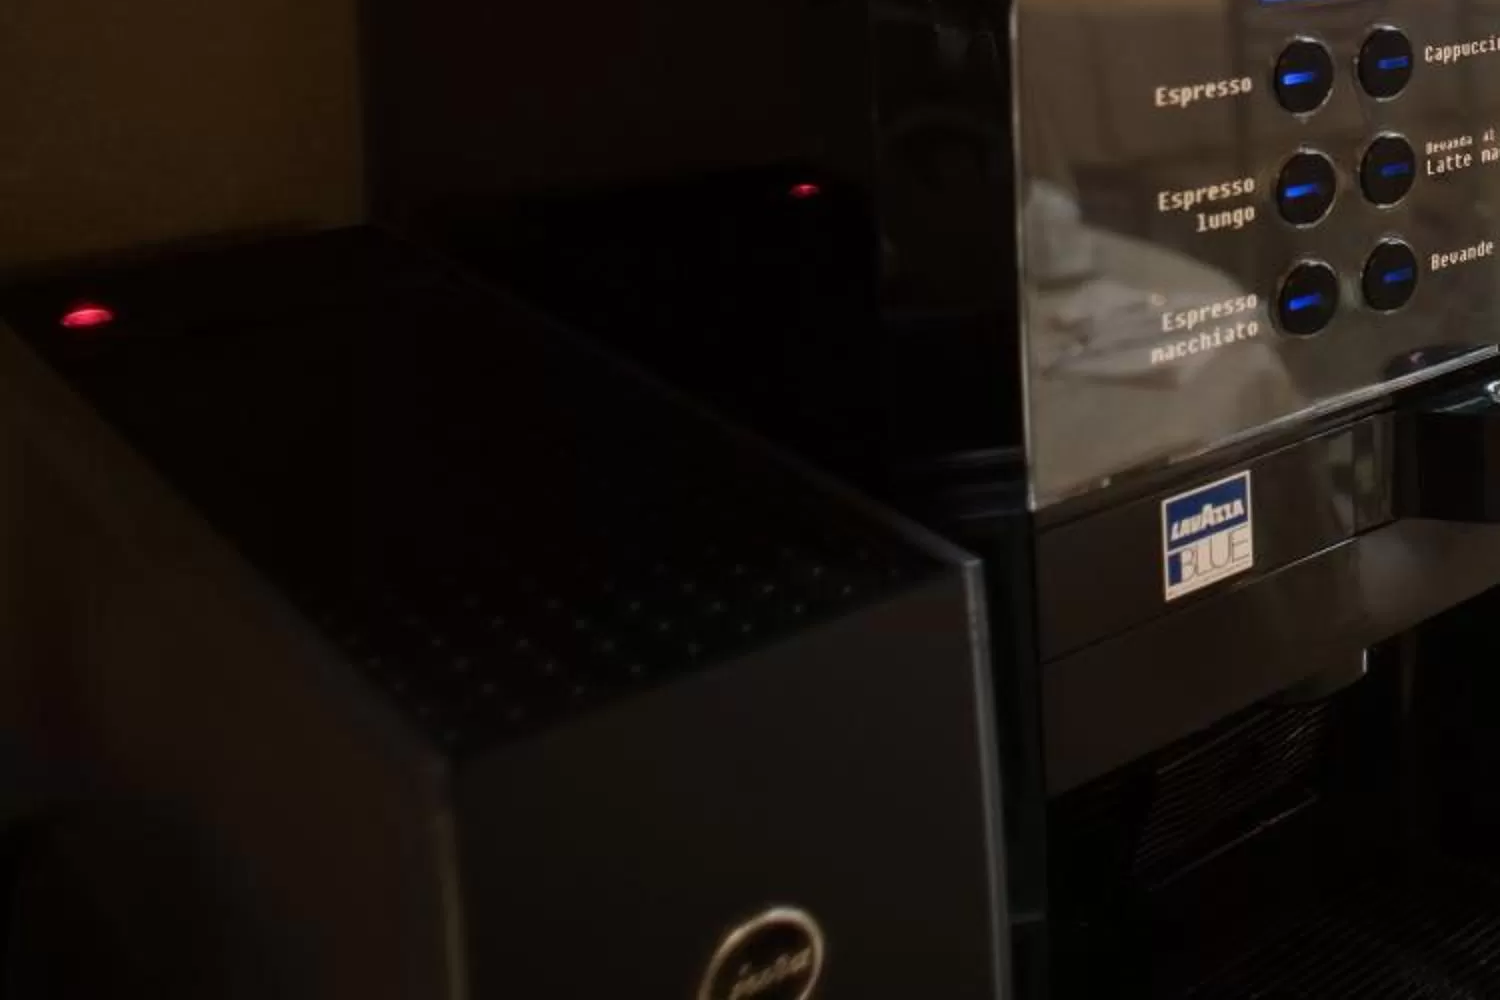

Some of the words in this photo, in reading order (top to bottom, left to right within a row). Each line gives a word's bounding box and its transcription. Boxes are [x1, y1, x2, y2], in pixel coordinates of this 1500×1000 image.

[1155, 77, 1252, 108] Espresso
[1427, 153, 1473, 176] Latte
[1158, 178, 1255, 212] Espresso
[1196, 206, 1255, 233] lungo
[1431, 240, 1494, 271] Bevande
[1162, 294, 1257, 332] Espresso
[1151, 321, 1259, 365] macchiato
[1171, 499, 1245, 541] LAVAZZA
[1178, 525, 1251, 584] BLUE
